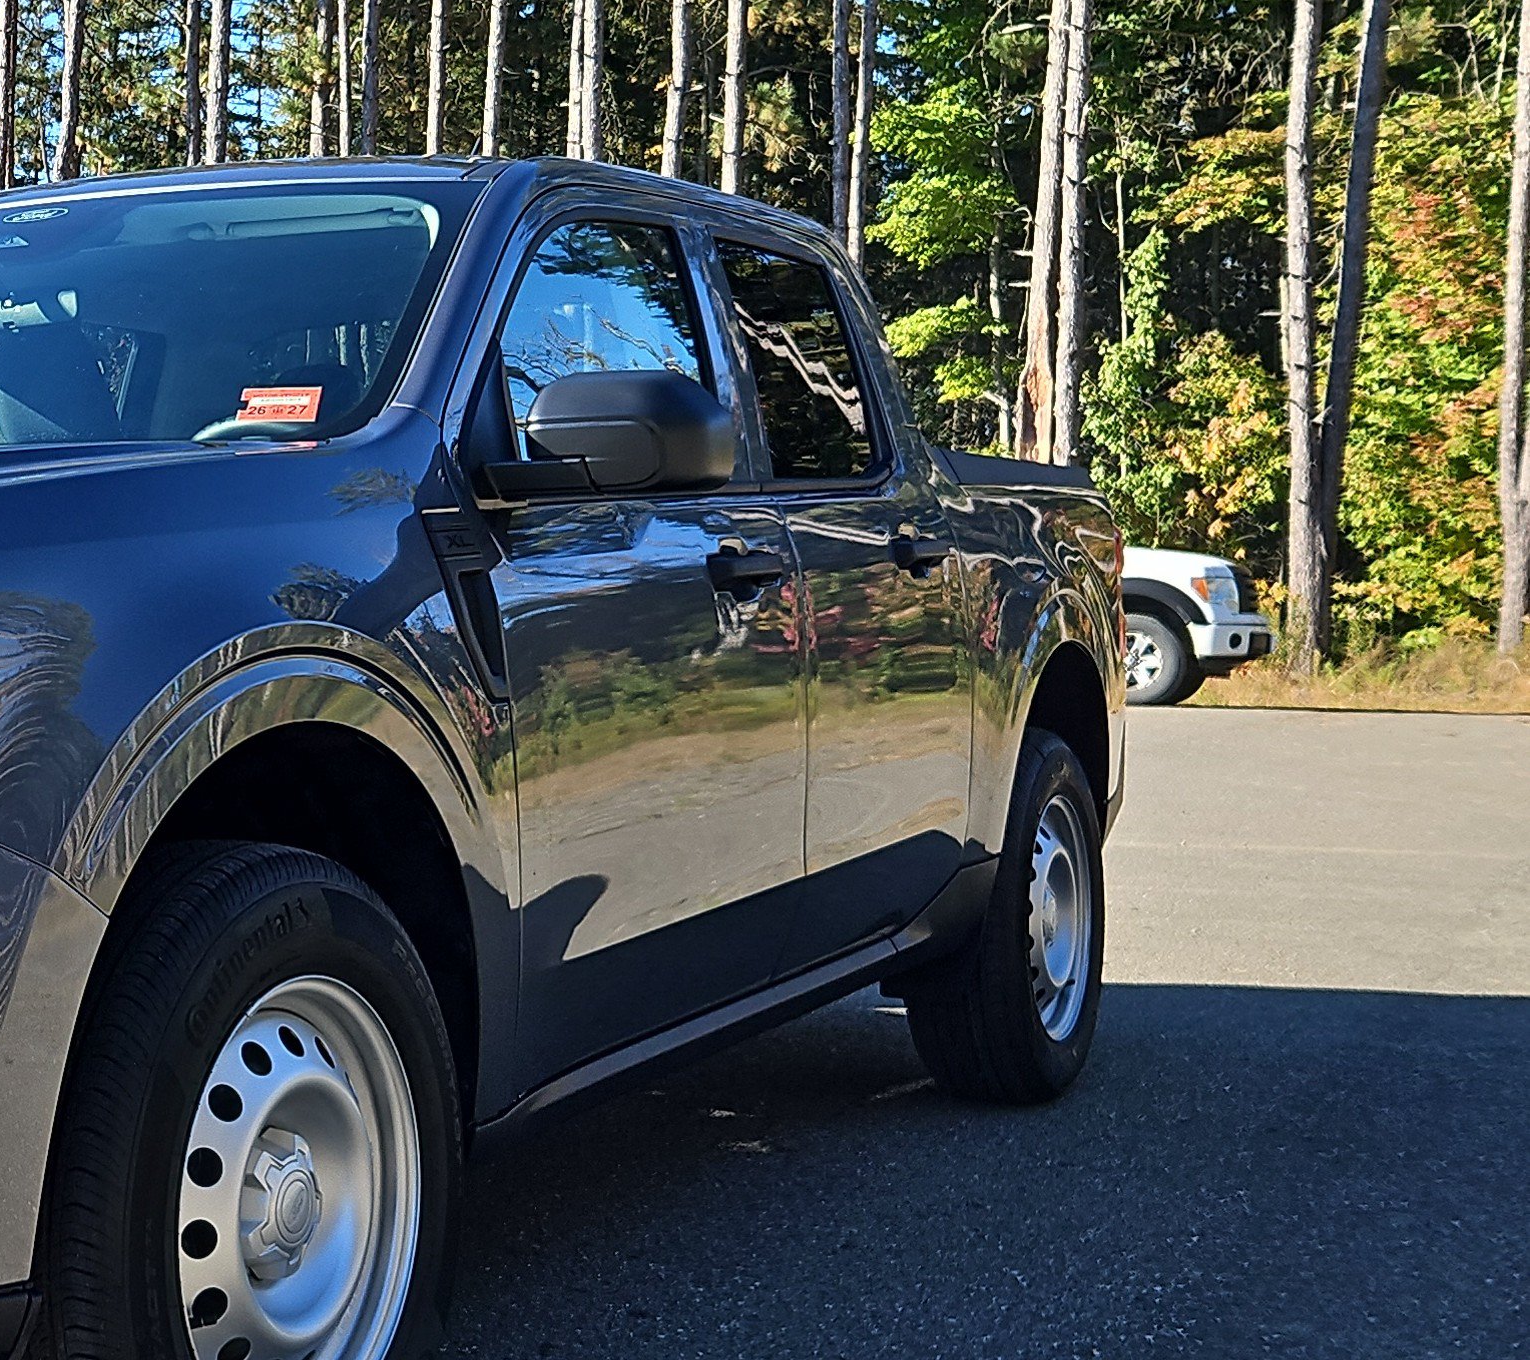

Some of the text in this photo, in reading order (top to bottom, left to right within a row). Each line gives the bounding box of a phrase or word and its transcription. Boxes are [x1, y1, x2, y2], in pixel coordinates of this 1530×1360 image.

[248, 406, 266, 415] 26
[287, 405, 308, 415] 27
[446, 534, 474, 548] XL
[185, 902, 293, 1048] Continental
